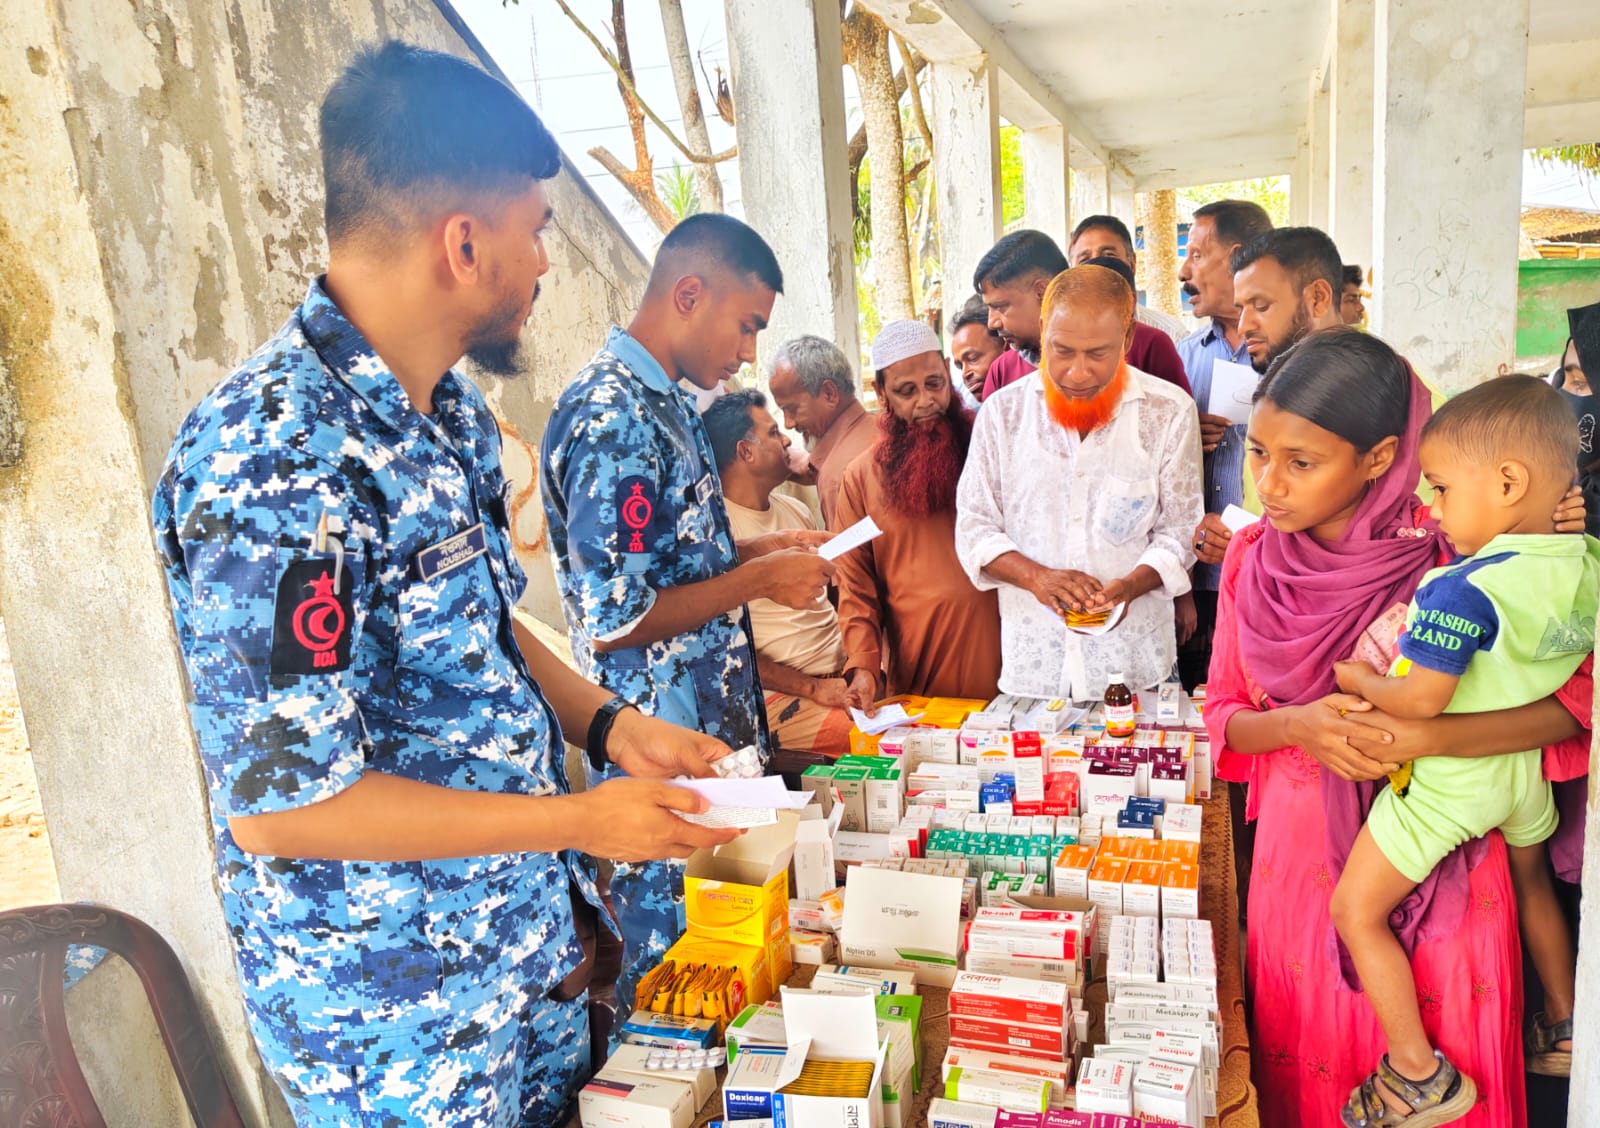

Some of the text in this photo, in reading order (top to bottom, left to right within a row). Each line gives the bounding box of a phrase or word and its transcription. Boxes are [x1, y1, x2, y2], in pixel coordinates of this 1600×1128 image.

[436, 545, 474, 570] NOUSHAD
[1428, 609, 1487, 638] FASHIO
[1155, 1007, 1200, 1019] Metaspray
[1159, 1047, 1195, 1057] Ambrox
[1148, 1061, 1185, 1073] Ambrox
[1047, 1115, 1082, 1126] Amodis
[1139, 1111, 1181, 1126] Ambrox
